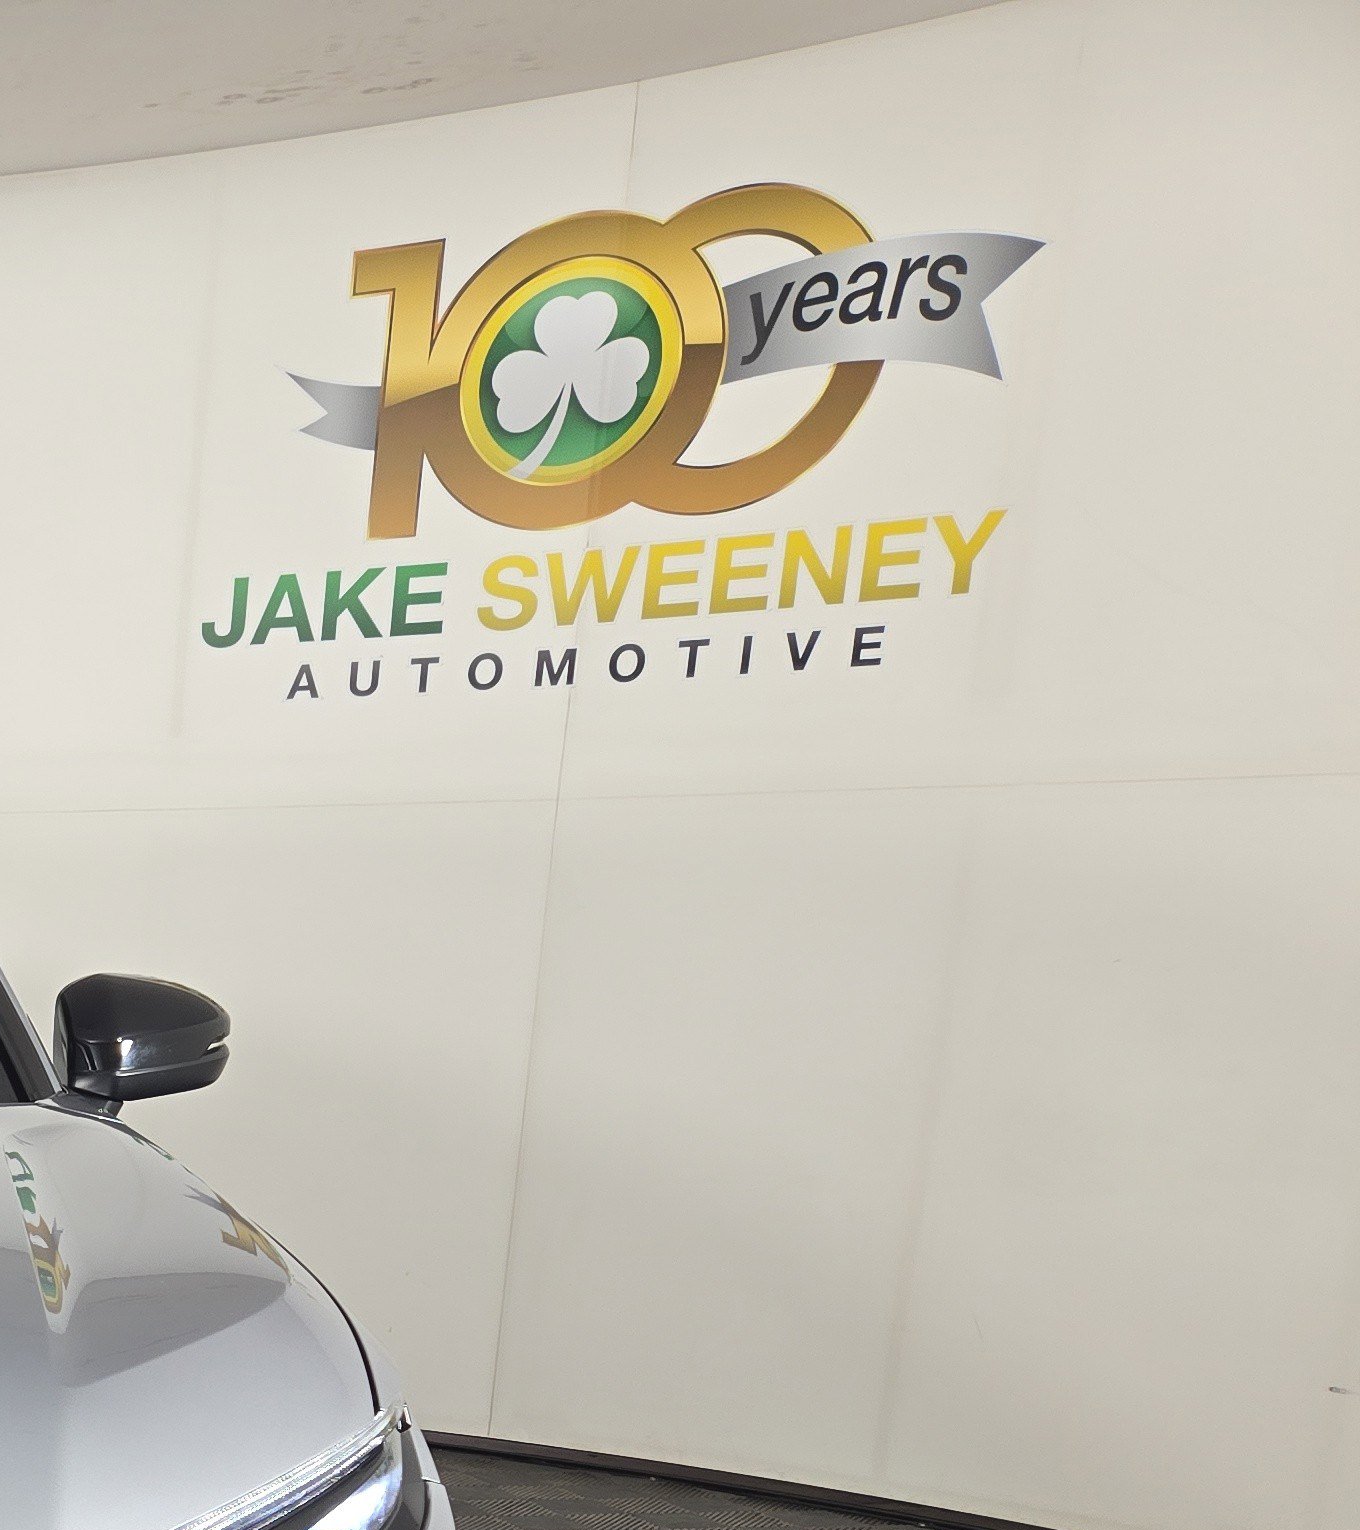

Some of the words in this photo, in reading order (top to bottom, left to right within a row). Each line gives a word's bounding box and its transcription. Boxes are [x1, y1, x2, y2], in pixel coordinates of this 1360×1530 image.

[740, 254, 968, 366] years
[201, 562, 448, 648] JAKE
[477, 509, 1008, 631] SWEENEY
[286, 626, 886, 701] AUTOMOTIVE
